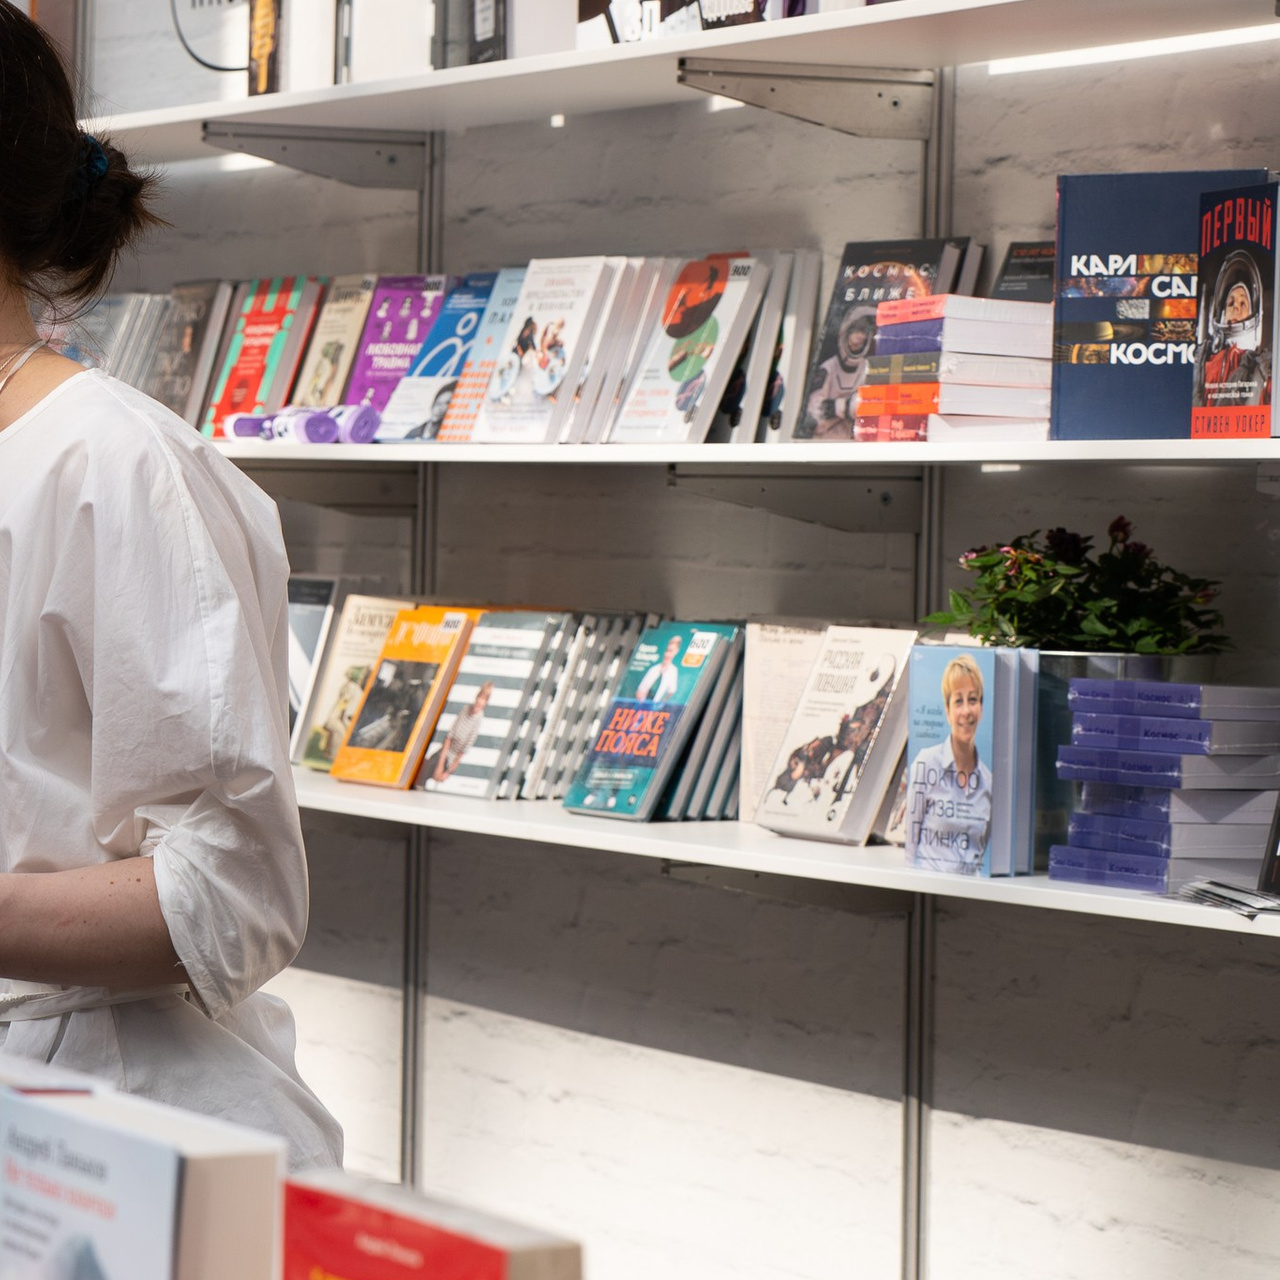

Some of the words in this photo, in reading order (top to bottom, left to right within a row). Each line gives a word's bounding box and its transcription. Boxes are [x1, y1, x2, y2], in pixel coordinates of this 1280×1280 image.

[1201, 197, 1272, 258] ПЕРВЫЙ
[844, 263, 930, 278] КОСМОС
[1071, 254, 1138, 276] КАРЛ
[844, 285, 917, 301] БЛИЖЕ
[1194, 414, 1230, 434] СТИВЕН
[1235, 413, 1265, 433] УОКЕР
[1137, 691, 1172, 702] Космос
[609, 707, 670, 735] НИЖЕ
[595, 730, 661, 758] ПОЯСА
[1143, 728, 1180, 740] Космос
[912, 761, 980, 791] Доктор
[911, 791, 955, 819] Лиза
[912, 821, 971, 851] Глинка
